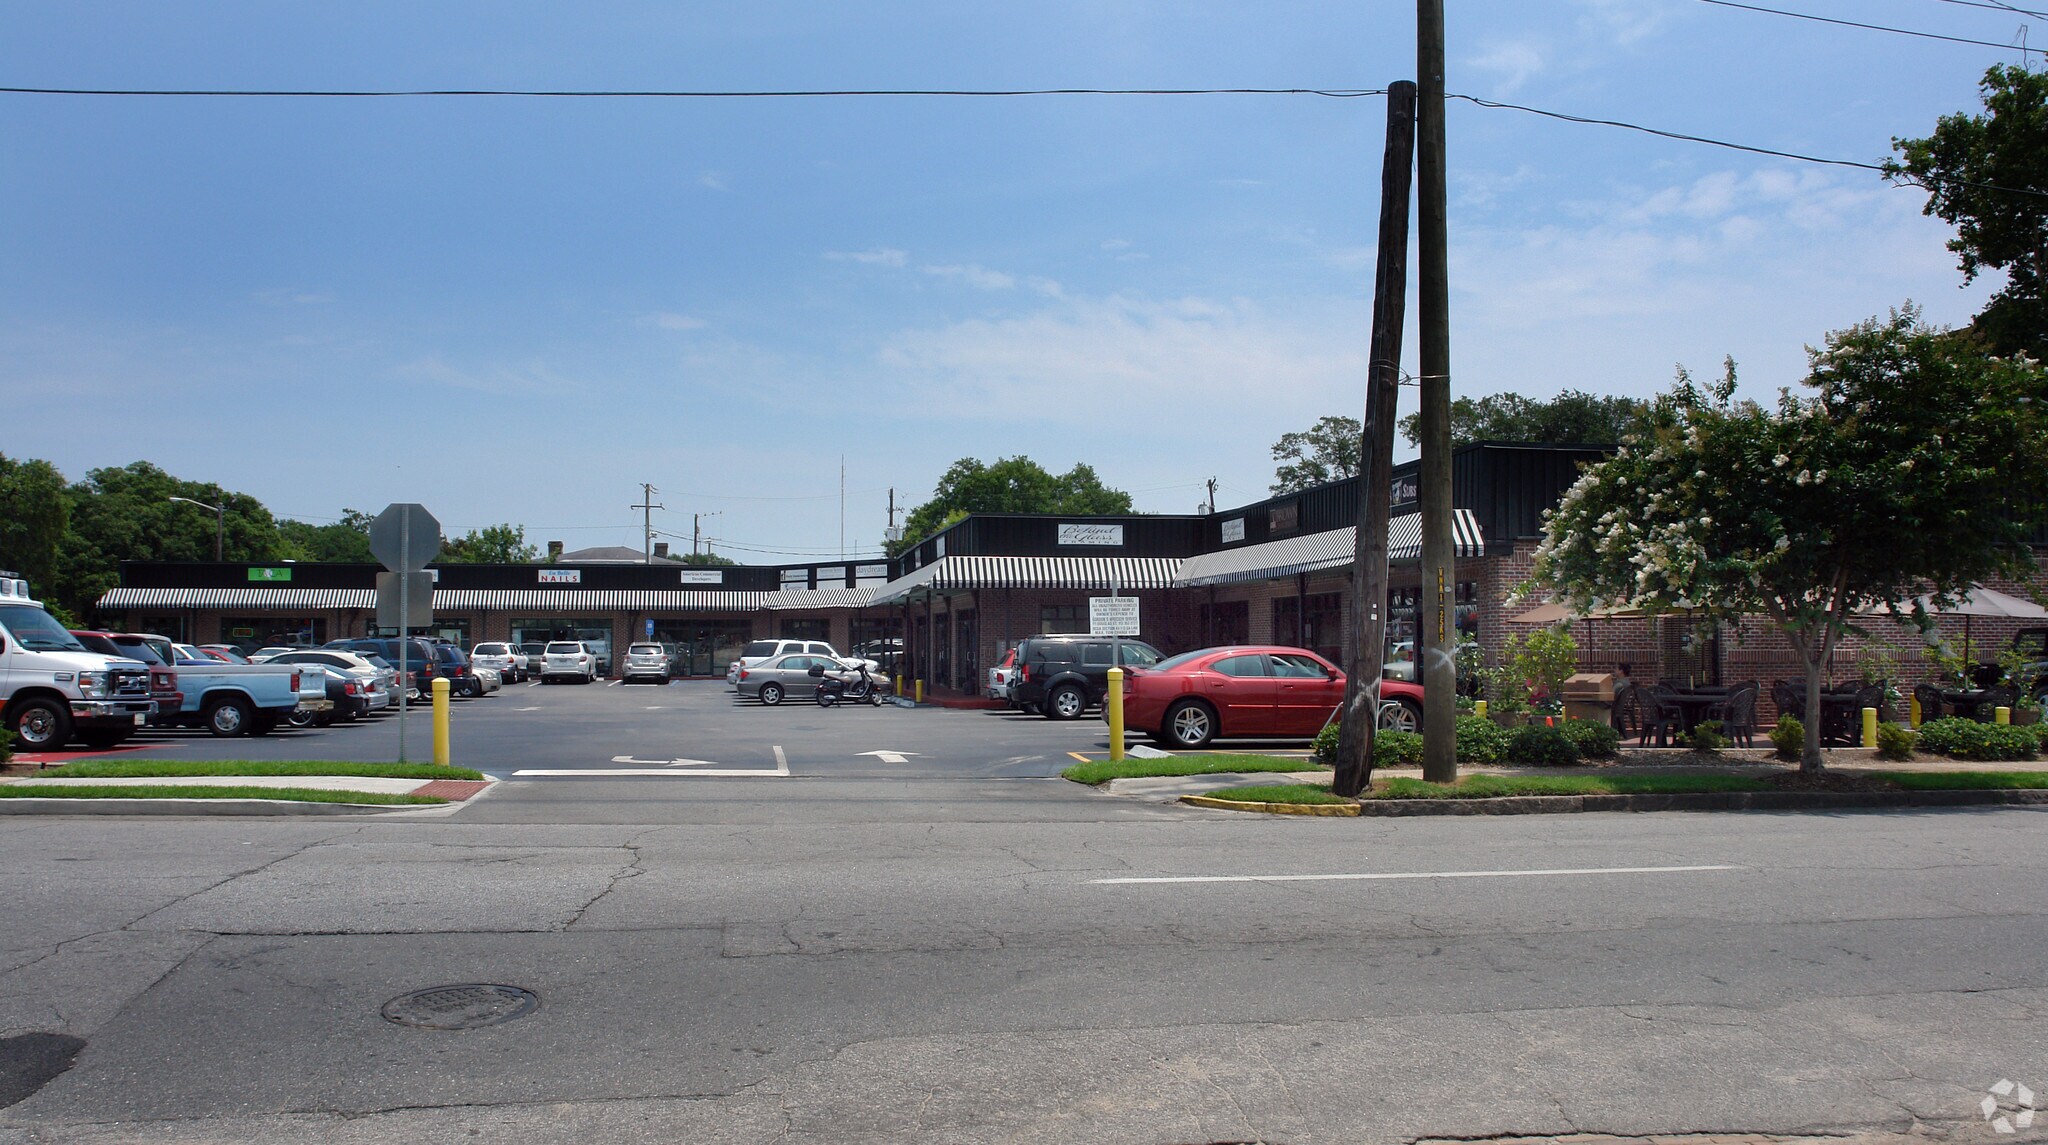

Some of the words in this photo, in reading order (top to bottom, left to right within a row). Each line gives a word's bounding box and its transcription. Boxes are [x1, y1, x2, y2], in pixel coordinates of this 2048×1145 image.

[1063, 525, 1122, 534] Behind
[1074, 534, 1113, 542] Glass
[856, 566, 887, 574] daydream
